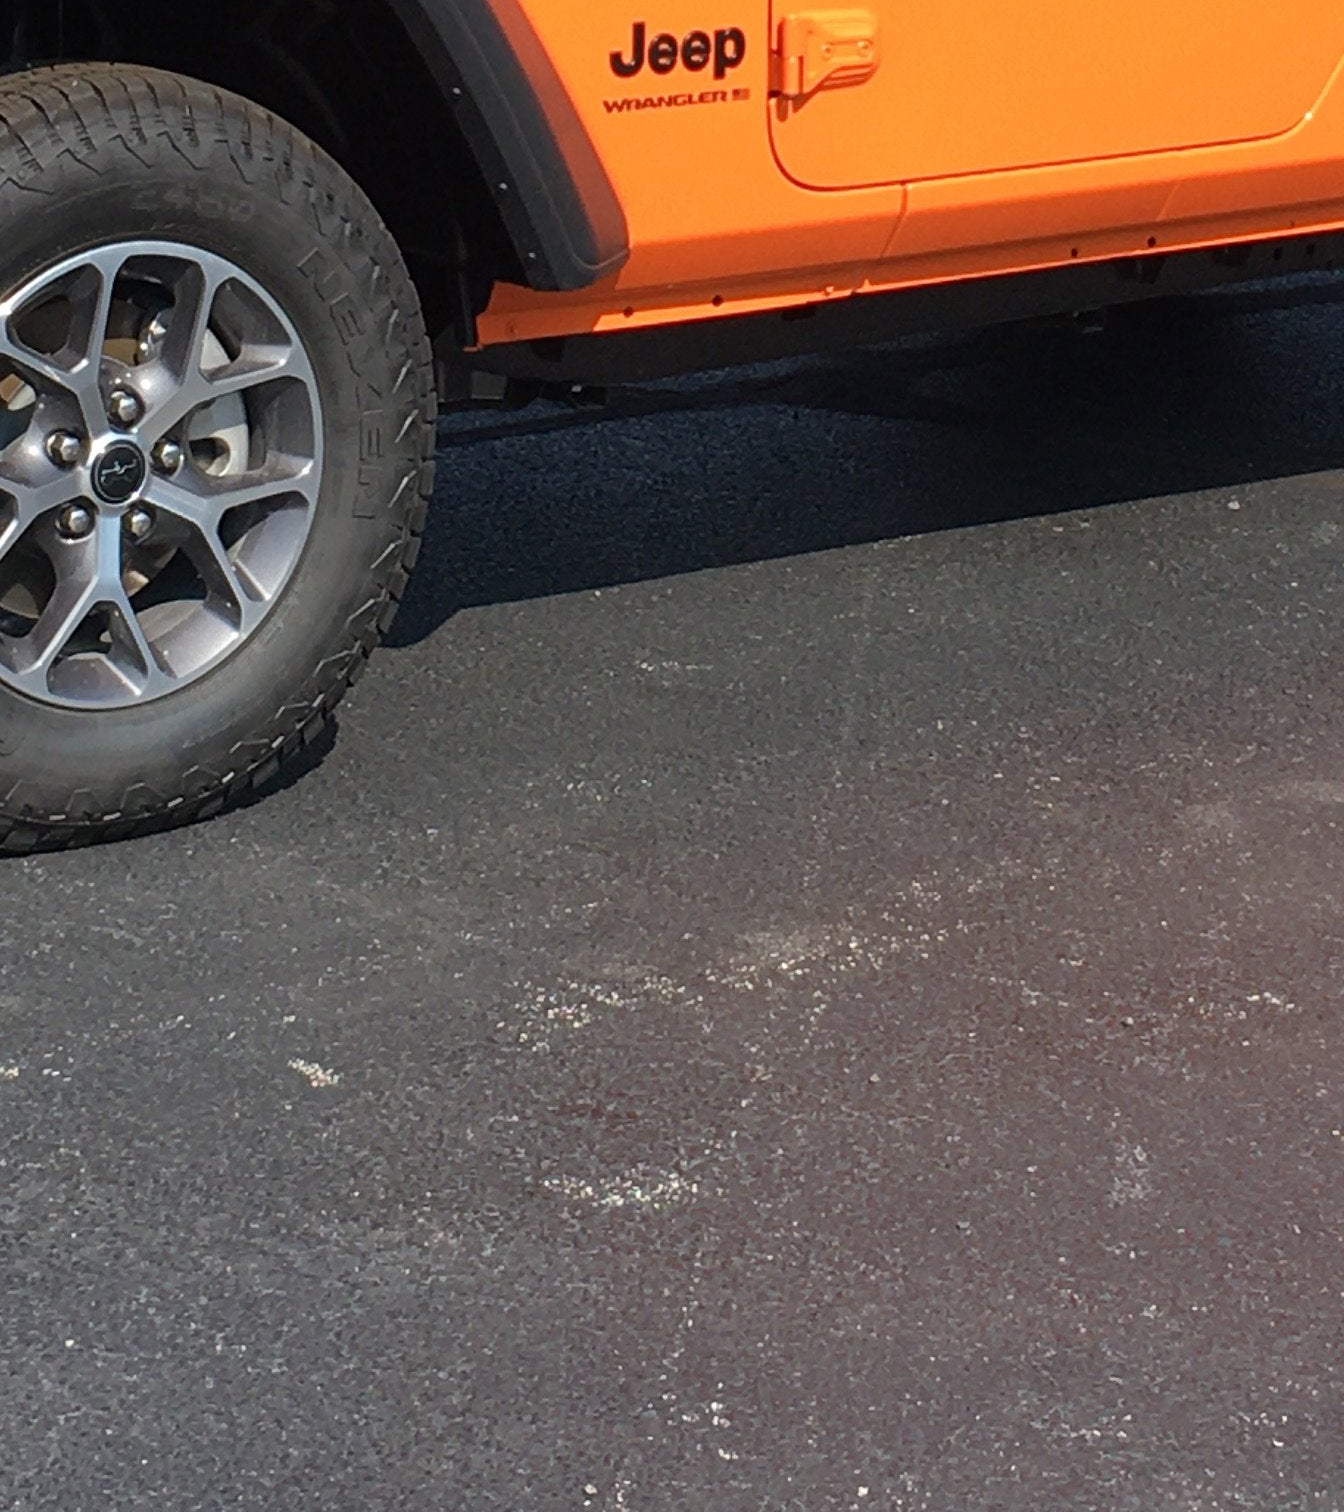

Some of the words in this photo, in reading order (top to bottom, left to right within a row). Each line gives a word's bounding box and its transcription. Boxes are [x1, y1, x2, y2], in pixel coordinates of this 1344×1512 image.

[609, 20, 746, 80] Jeep
[602, 89, 728, 114] WRANGLER
[297, 245, 387, 520] NEXEN
